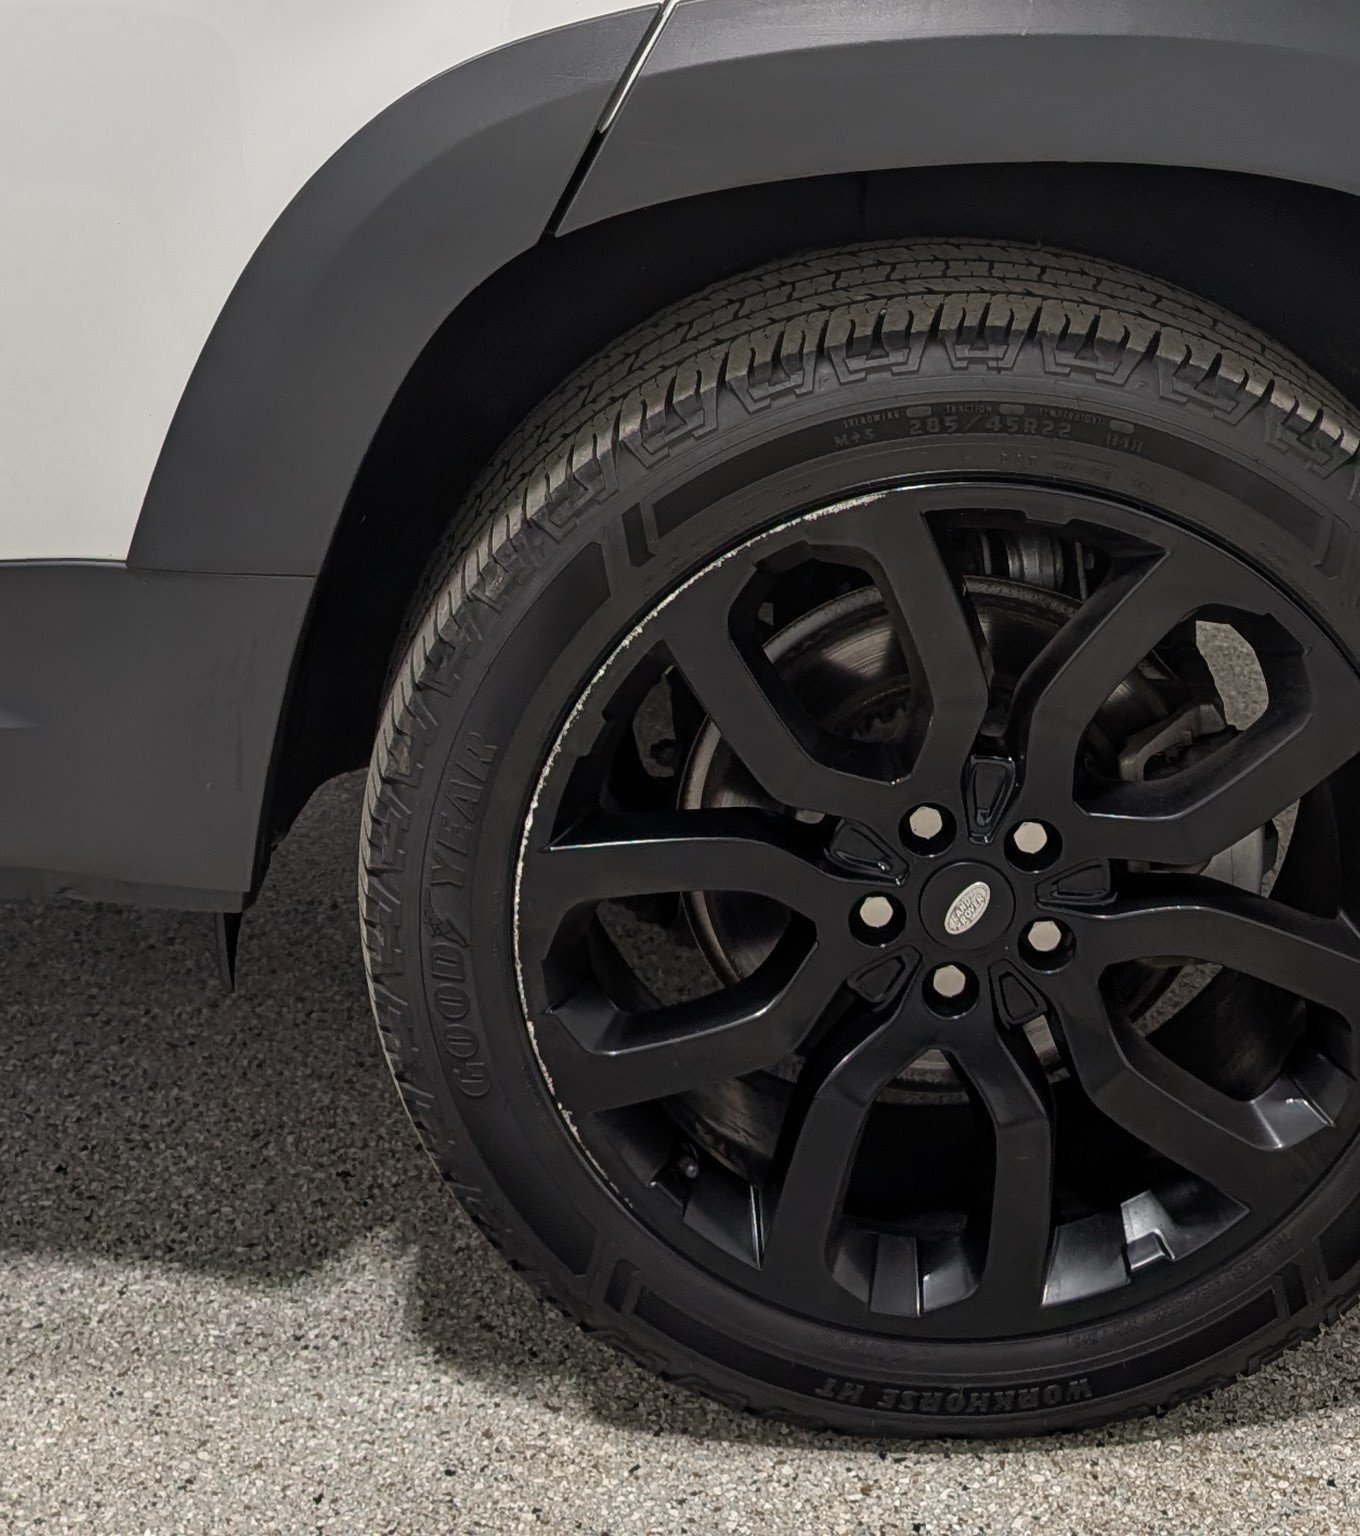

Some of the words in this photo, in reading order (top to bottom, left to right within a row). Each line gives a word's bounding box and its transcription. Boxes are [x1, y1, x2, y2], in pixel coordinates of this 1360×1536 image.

[909, 415, 1072, 438] 285/45R22
[949, 897, 971, 926] LAND
[959, 894, 985, 927] ROVER
[814, 1378, 864, 1403] HT
[877, 1378, 1093, 1415] WORKHORSE
